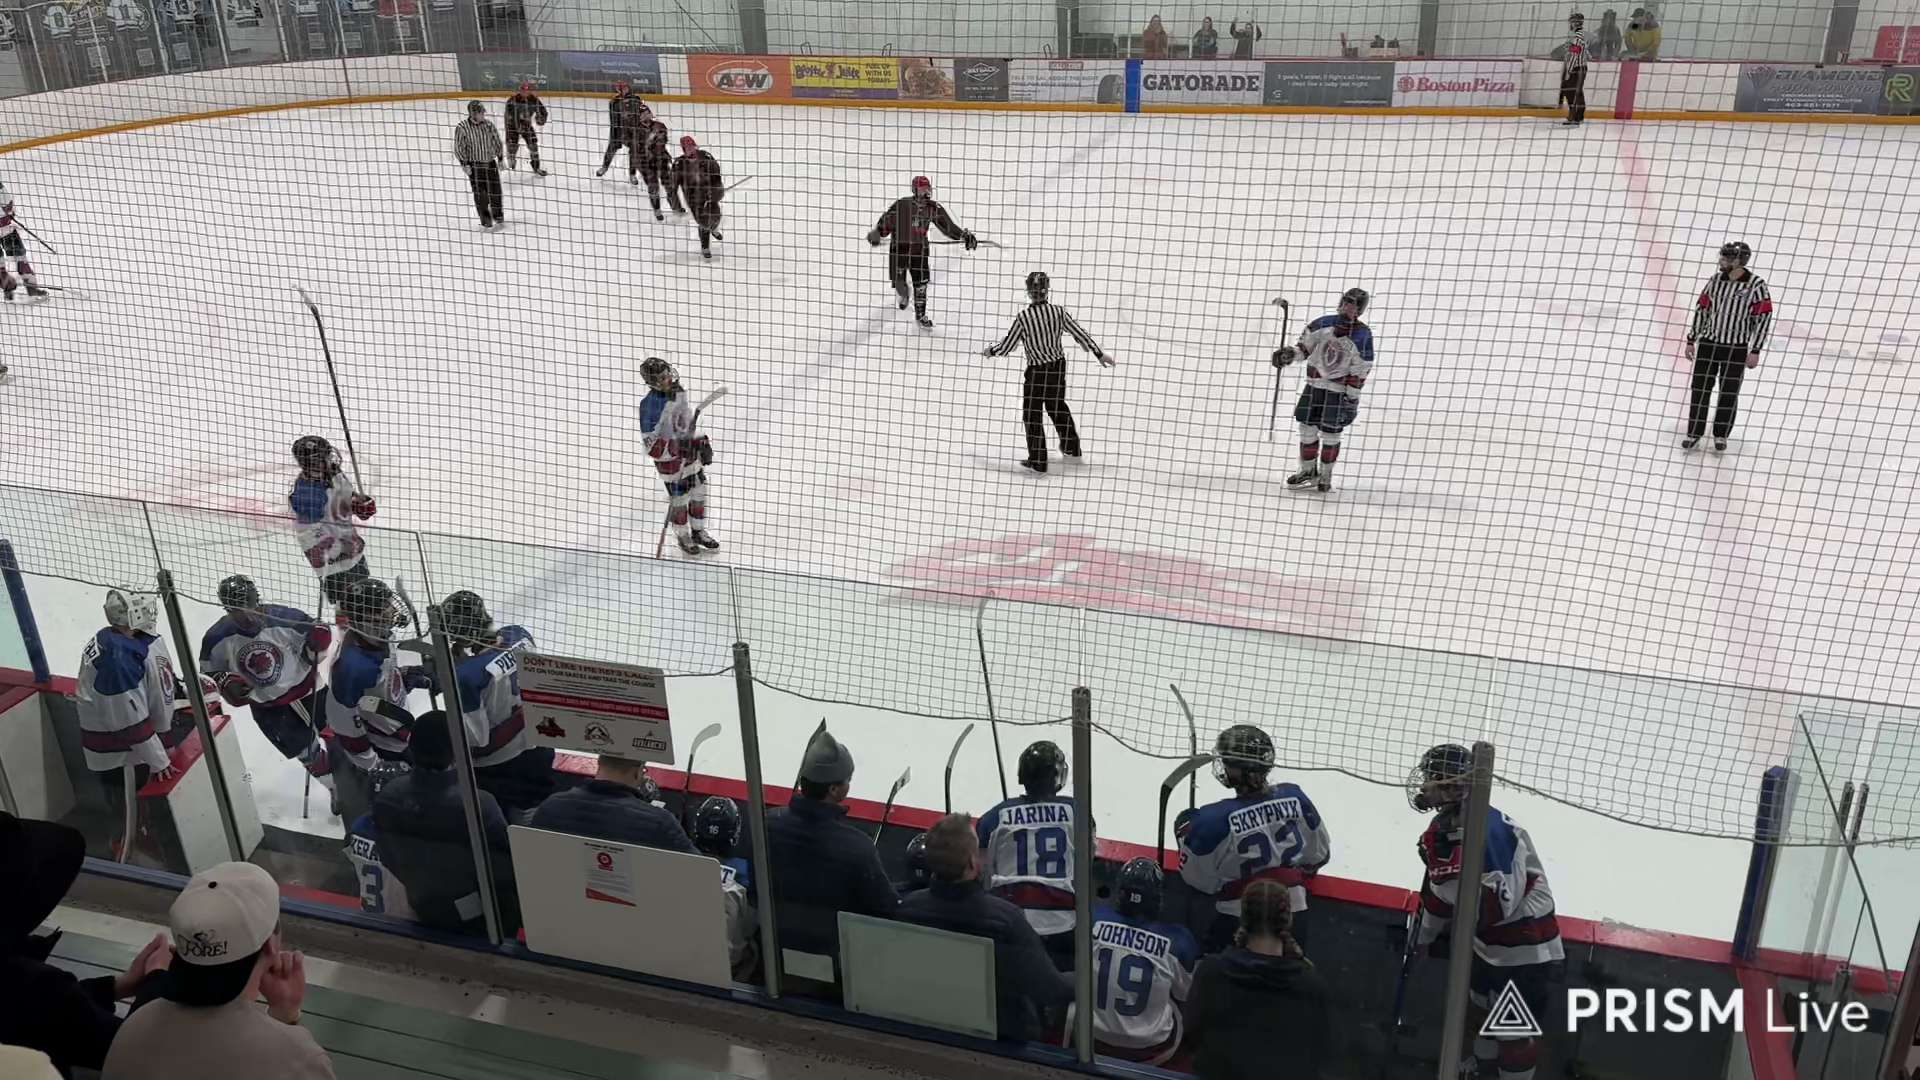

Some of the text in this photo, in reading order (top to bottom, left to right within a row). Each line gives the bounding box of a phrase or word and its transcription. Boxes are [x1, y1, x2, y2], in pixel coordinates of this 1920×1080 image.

[1143, 74, 1260, 91] GATORADE
[1417, 77, 1515, 93] Boston Pizza
[523, 656, 554, 669] DON'T
[555, 660, 579, 671] LIKE
[1003, 805, 1069, 826] JARINA
[1230, 801, 1300, 834] SKRYPNYK
[709, 824, 719, 835] 16
[1013, 827, 1068, 878] 18
[1237, 819, 1305, 880] 22
[1130, 892, 1142, 904] 19
[1093, 922, 1168, 958] JOHNSON
[1097, 947, 1154, 1017] 19
